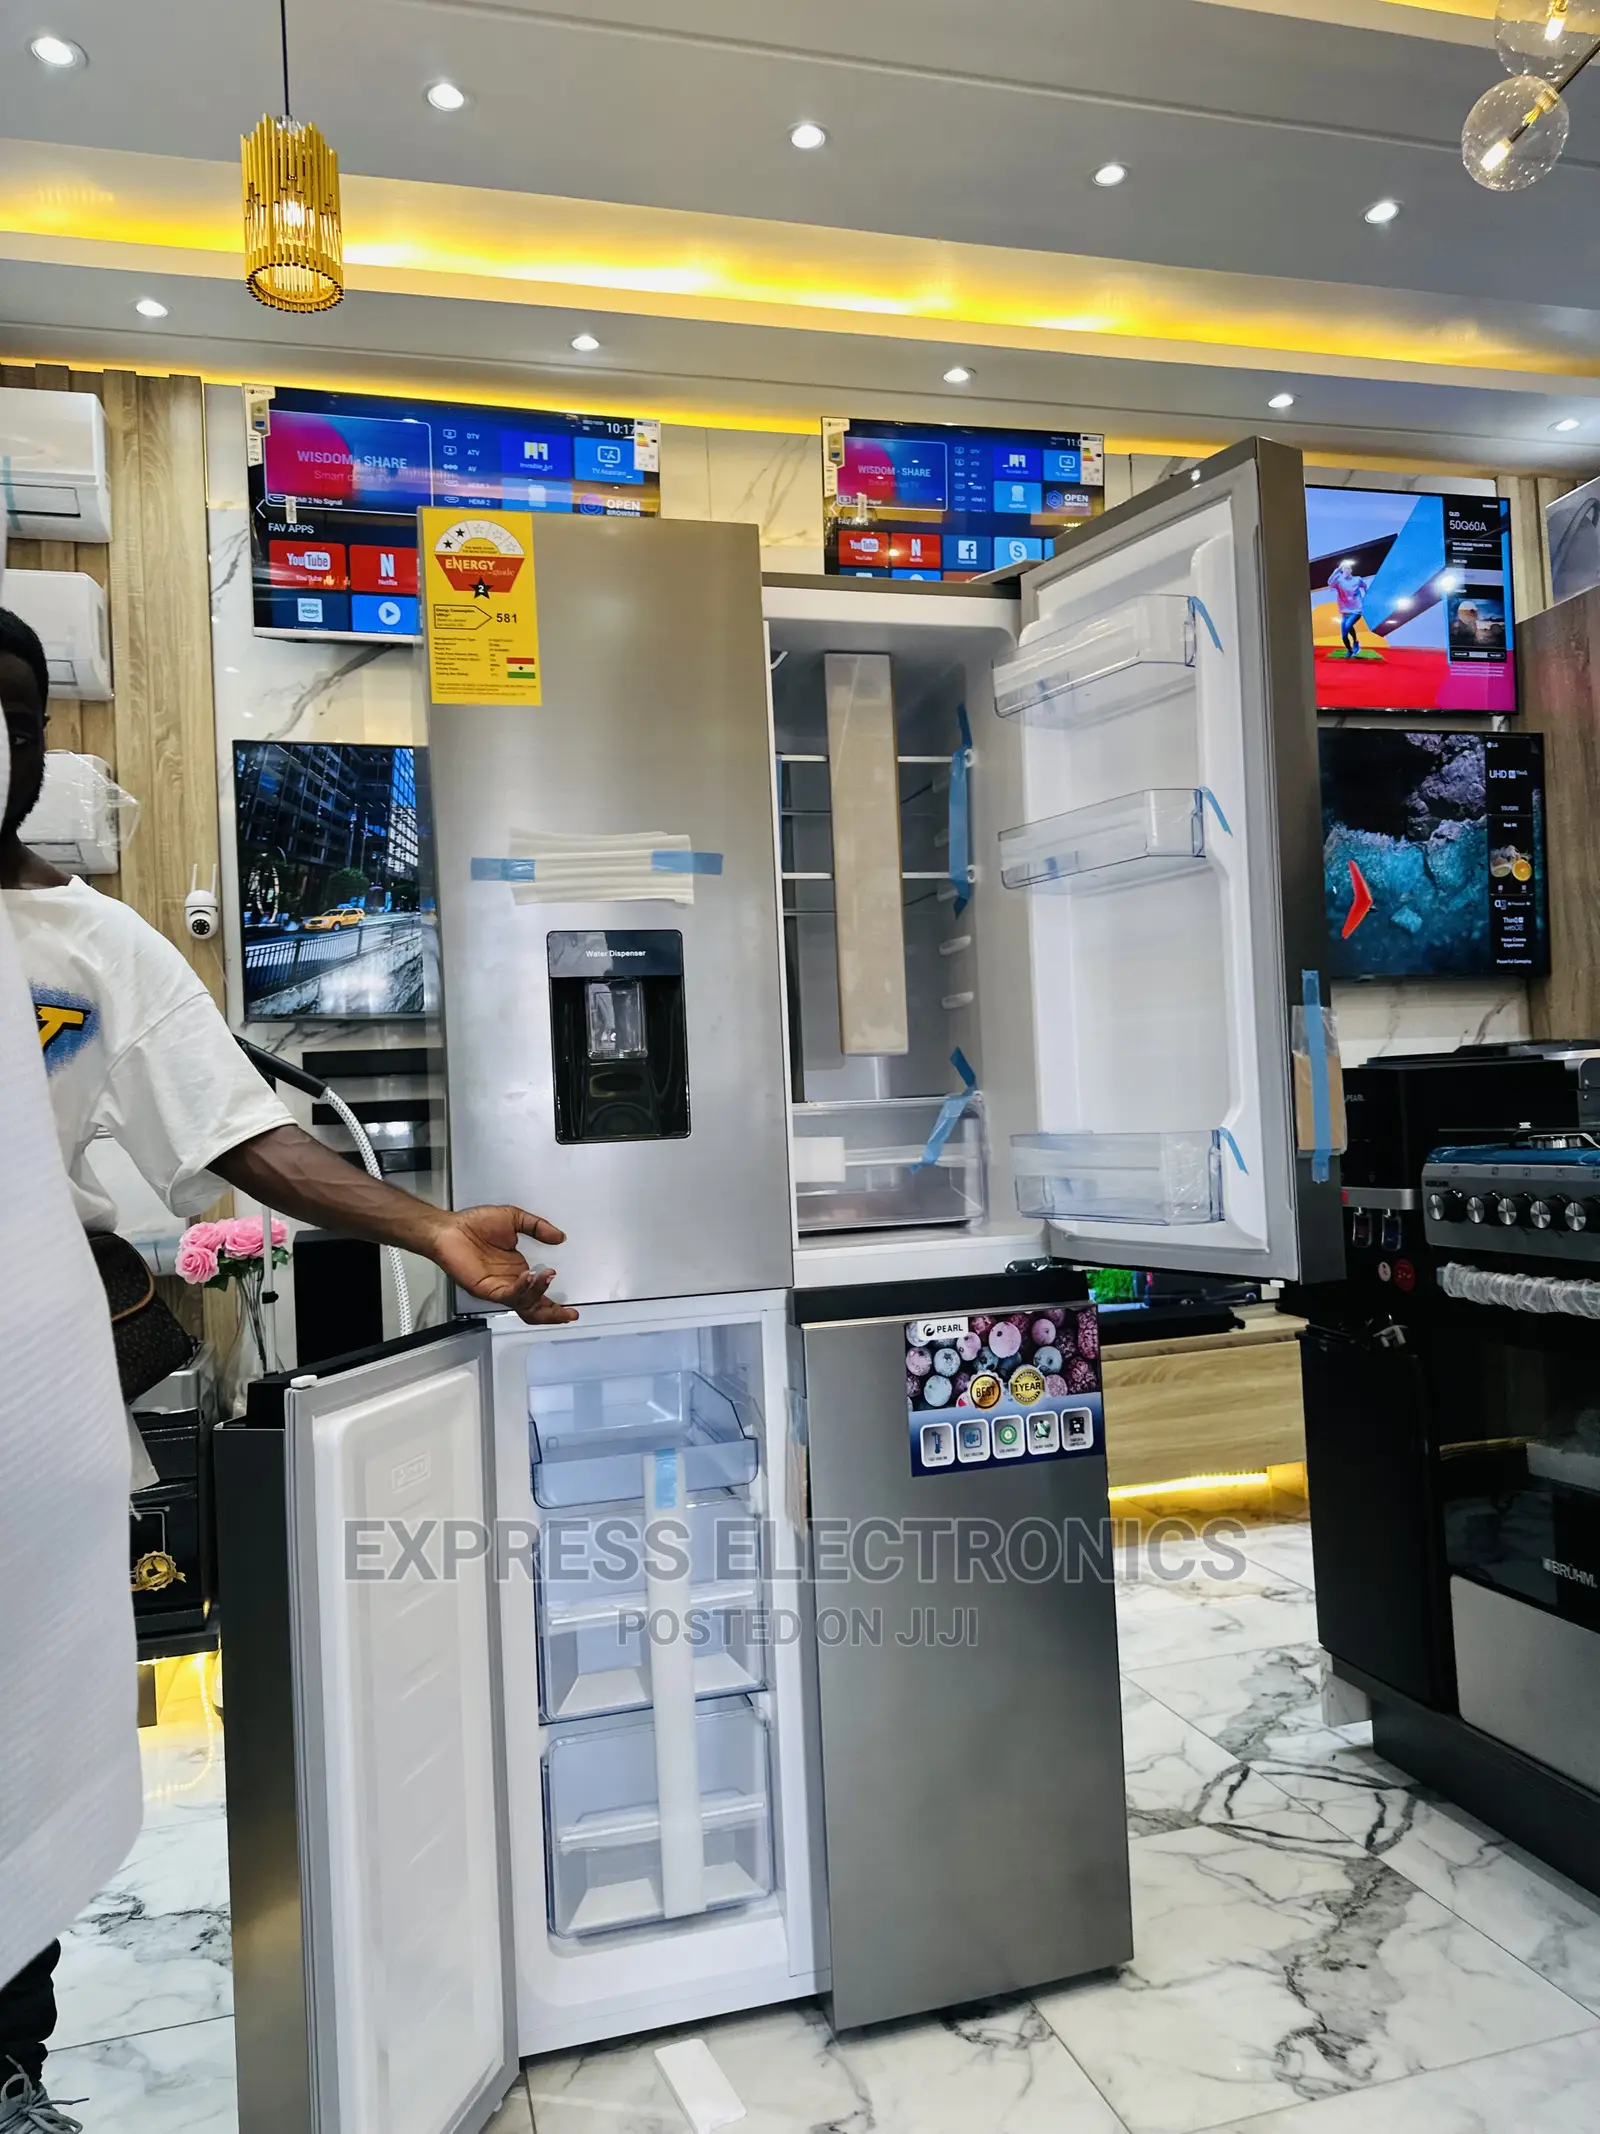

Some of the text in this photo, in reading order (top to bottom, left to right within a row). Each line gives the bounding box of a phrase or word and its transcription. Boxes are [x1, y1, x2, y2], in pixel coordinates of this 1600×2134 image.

[466, 432, 480, 440] DTV
[467, 449, 480, 457] ATV
[296, 450, 408, 469] WISDOM SHARE
[857, 465, 932, 477] WISDOM SHARE
[323, 498, 343, 506] Signal
[468, 498, 485, 506] HDMI
[1064, 493, 1089, 502] OPEN
[606, 499, 641, 511] OPEN
[268, 522, 315, 535] FAV APPS
[1449, 519, 1487, 532] 50Q60A
[286, 552, 330, 568] YouTube
[445, 556, 496, 572] ENERGY
[478, 584, 485, 593] 2
[496, 613, 518, 624] 581
[1488, 769, 1508, 779] UHD
[585, 949, 647, 959] Water Dispenser
[936, 1324, 964, 1334] PEARL
[976, 1386, 995, 1398] BEST
